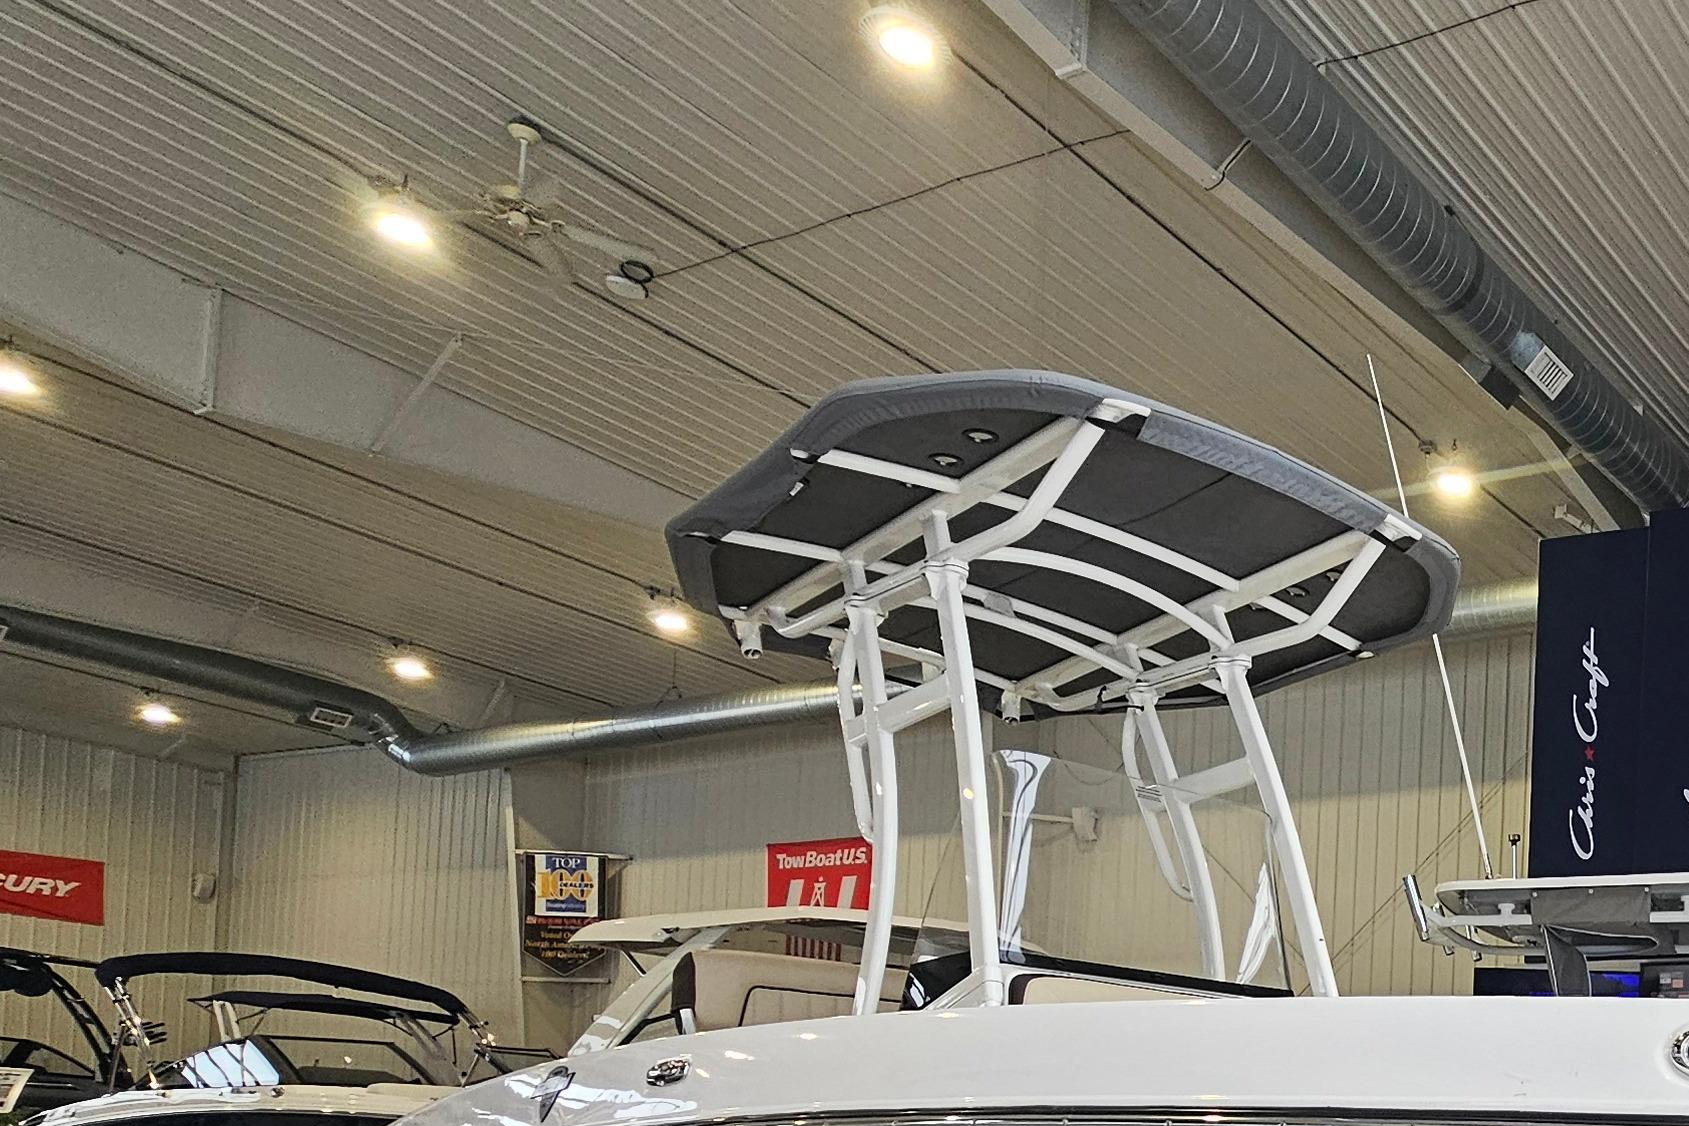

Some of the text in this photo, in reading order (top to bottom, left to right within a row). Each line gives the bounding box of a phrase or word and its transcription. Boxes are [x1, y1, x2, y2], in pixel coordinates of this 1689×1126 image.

[1569, 627, 1610, 860] Chris Craft
[552, 857, 580, 868] TOP
[537, 868, 594, 901] 100
